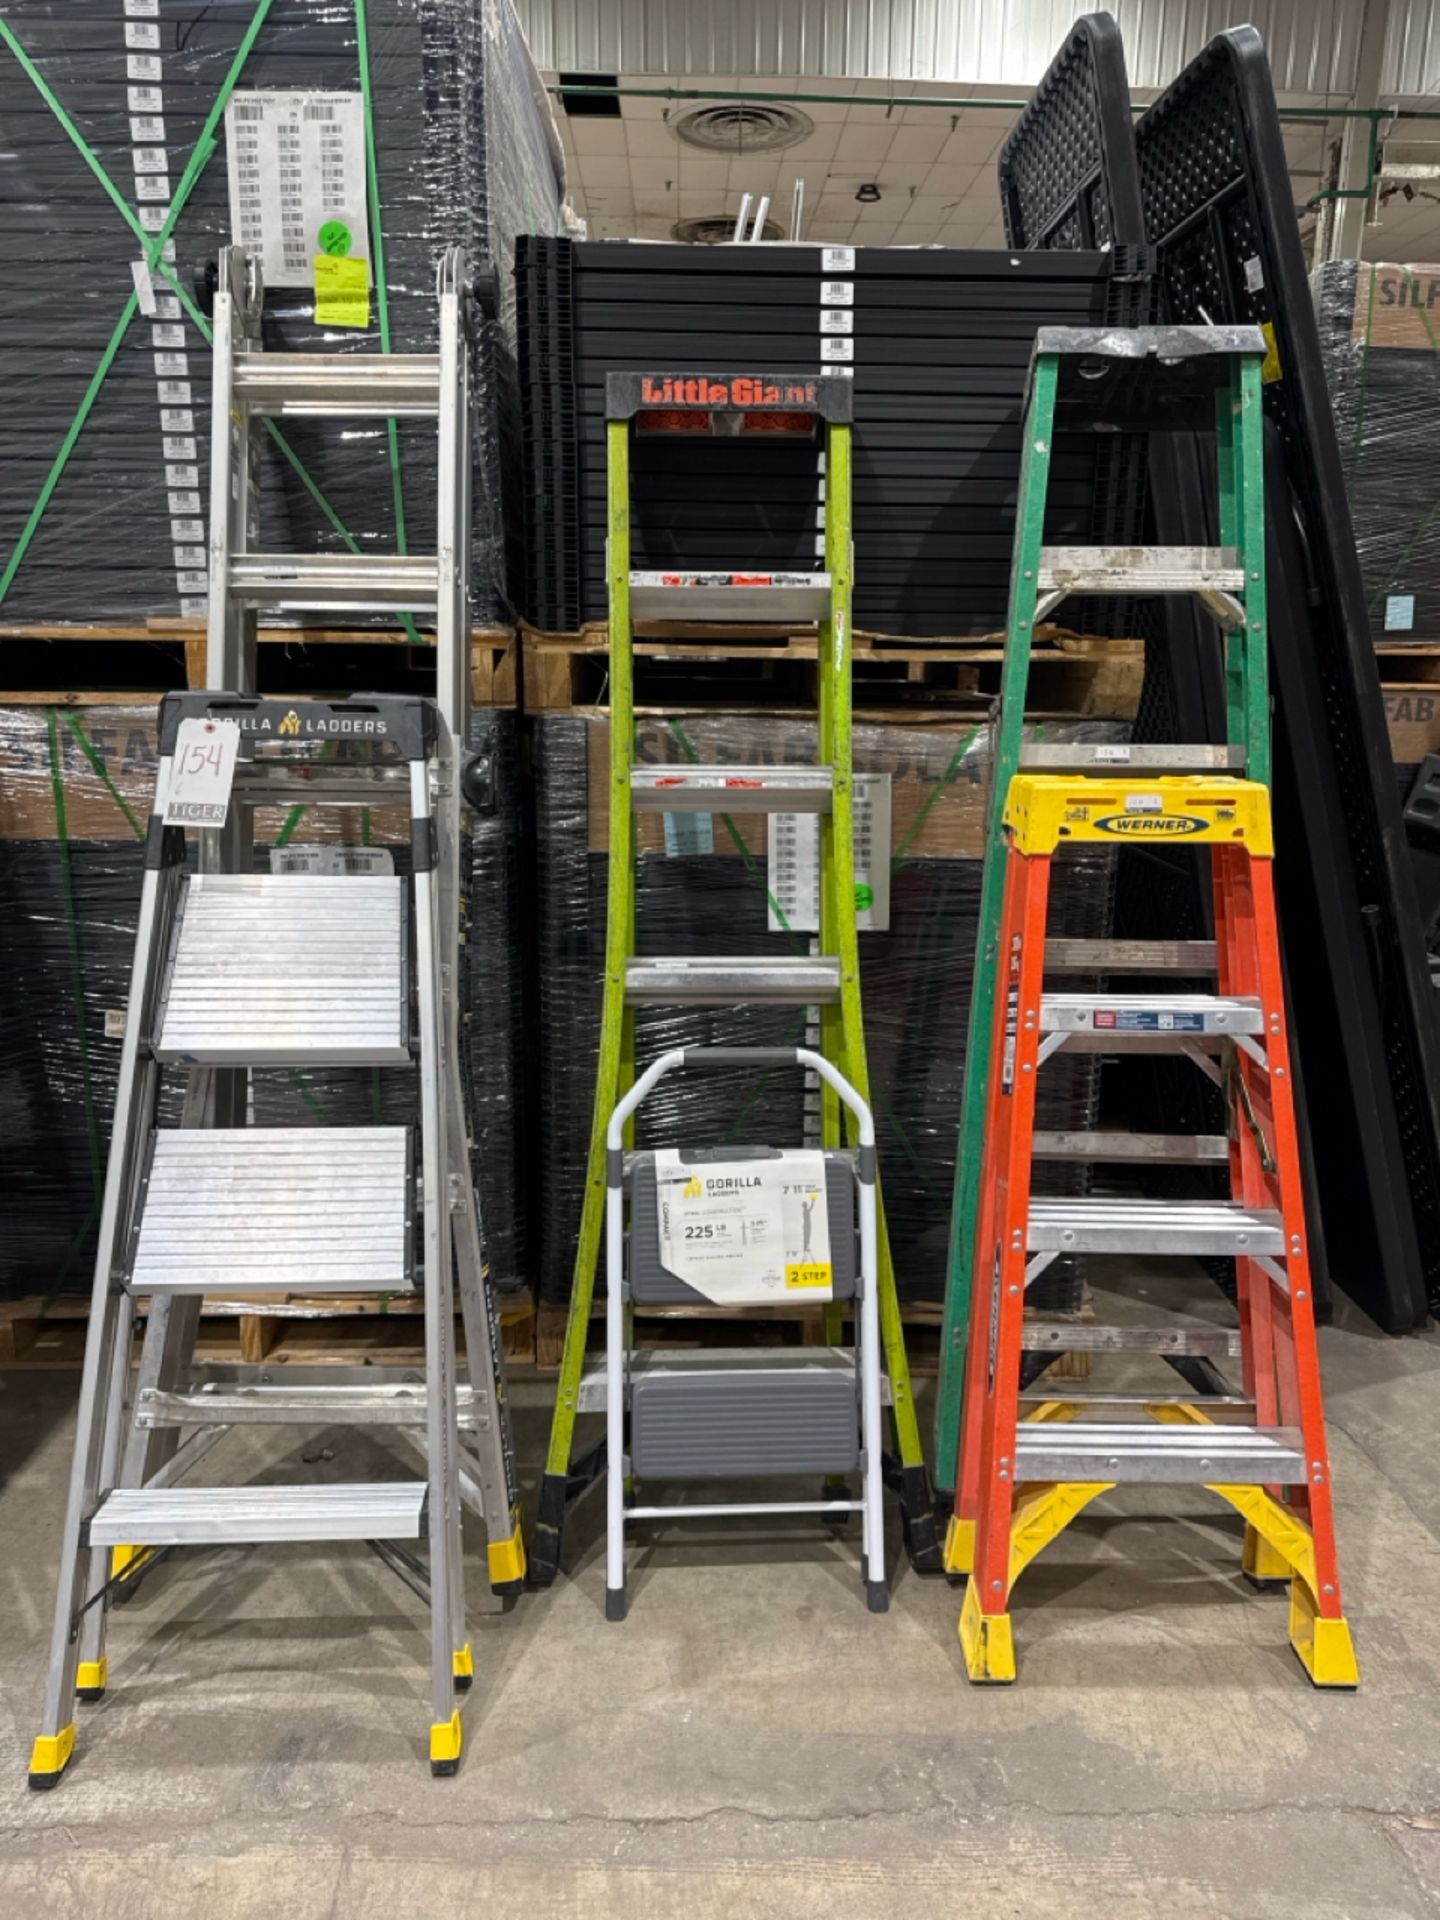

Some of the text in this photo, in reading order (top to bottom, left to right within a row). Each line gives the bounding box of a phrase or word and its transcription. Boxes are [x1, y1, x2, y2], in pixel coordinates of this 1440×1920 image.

[642, 376, 817, 405] Little Giant
[306, 719, 388, 734] LADDERS
[178, 743, 223, 776] 154
[170, 803, 223, 819] TIGER
[1116, 820, 1188, 830] WERNER
[706, 1177, 761, 1189] GORILLA
[684, 1224, 713, 1239] 225
[791, 1271, 799, 1283] 2
[802, 1271, 827, 1281] STEP
